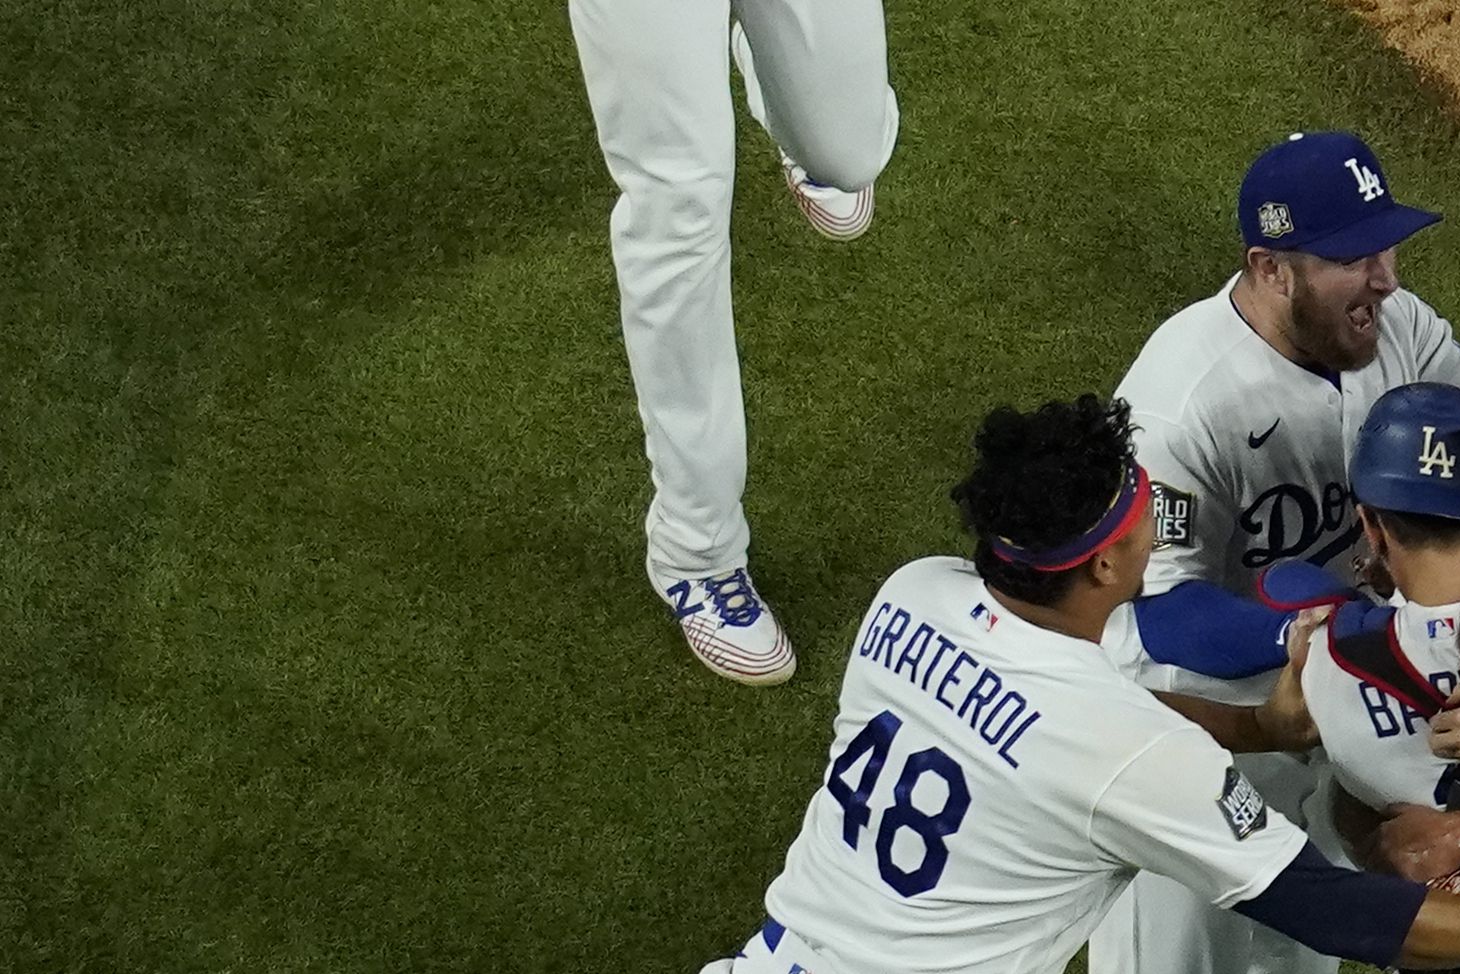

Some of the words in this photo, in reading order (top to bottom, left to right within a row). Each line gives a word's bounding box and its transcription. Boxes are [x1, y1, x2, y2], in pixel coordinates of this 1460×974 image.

[1344, 158, 1385, 202] LA
[1418, 425, 1456, 479] LA
[1153, 497, 1188, 519] RLD
[1156, 517, 1187, 540] IES
[859, 602, 1042, 771] GRATEROL
[827, 709, 973, 899] 48
